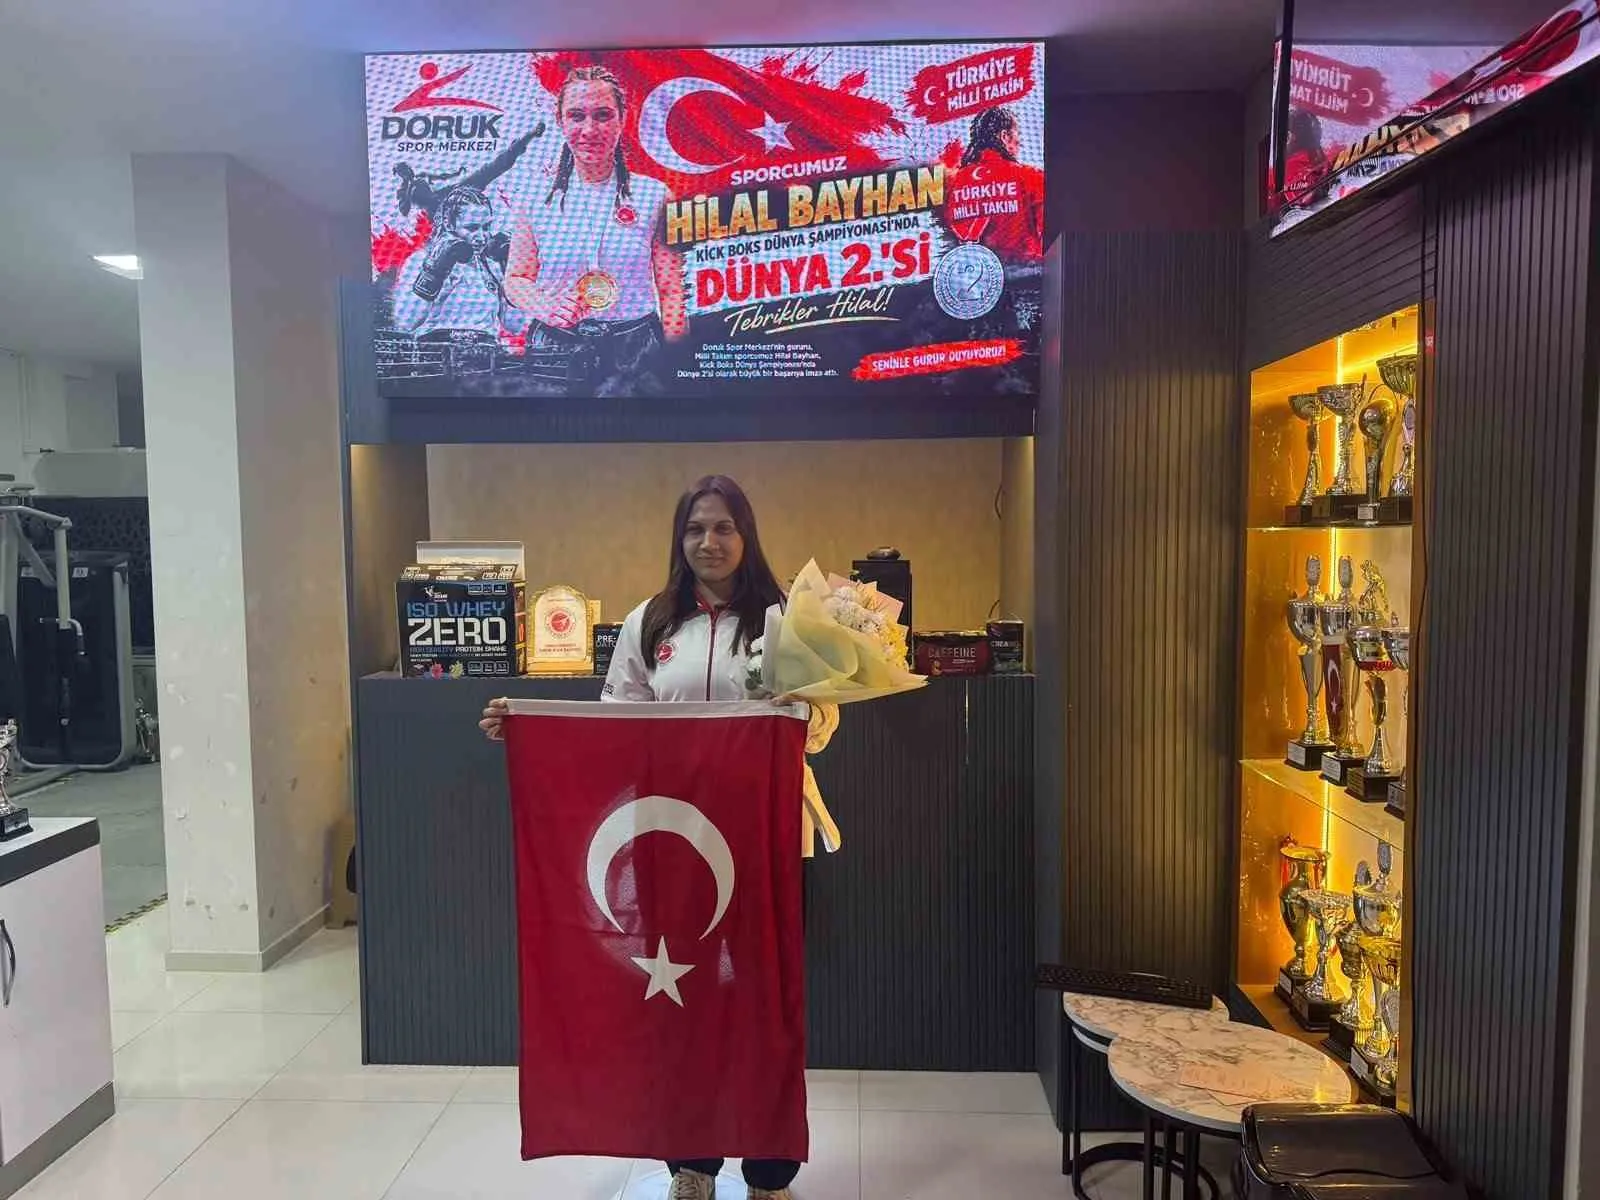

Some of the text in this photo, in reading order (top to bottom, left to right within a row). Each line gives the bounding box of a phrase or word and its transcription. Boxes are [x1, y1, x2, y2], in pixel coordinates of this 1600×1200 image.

[945, 55, 1016, 91] TÜRKİYE
[947, 86, 980, 112] MİLLİ
[381, 114, 504, 140] DORUK
[397, 140, 497, 152] SPOR MERKEZİ
[730, 156, 847, 186] SPORCUMUZ
[953, 181, 1017, 203] TÜRKİYE
[666, 165, 946, 246] HİLAL BAYHAN
[953, 201, 980, 220] MİLLİ
[696, 245, 724, 262] KİCK
[728, 241, 761, 257] BOKS
[764, 233, 805, 251] DÜNYA
[696, 252, 832, 308] DÜNYA
[724, 285, 894, 337] Tebrikler Hilal!
[677, 370, 700, 379] Dünya
[872, 356, 910, 372] SENİNLE
[913, 352, 946, 367] GURUR
[407, 601, 505, 617] ISO WHEY
[407, 617, 507, 645] ZERO
[928, 647, 977, 658] CAFFEINE
